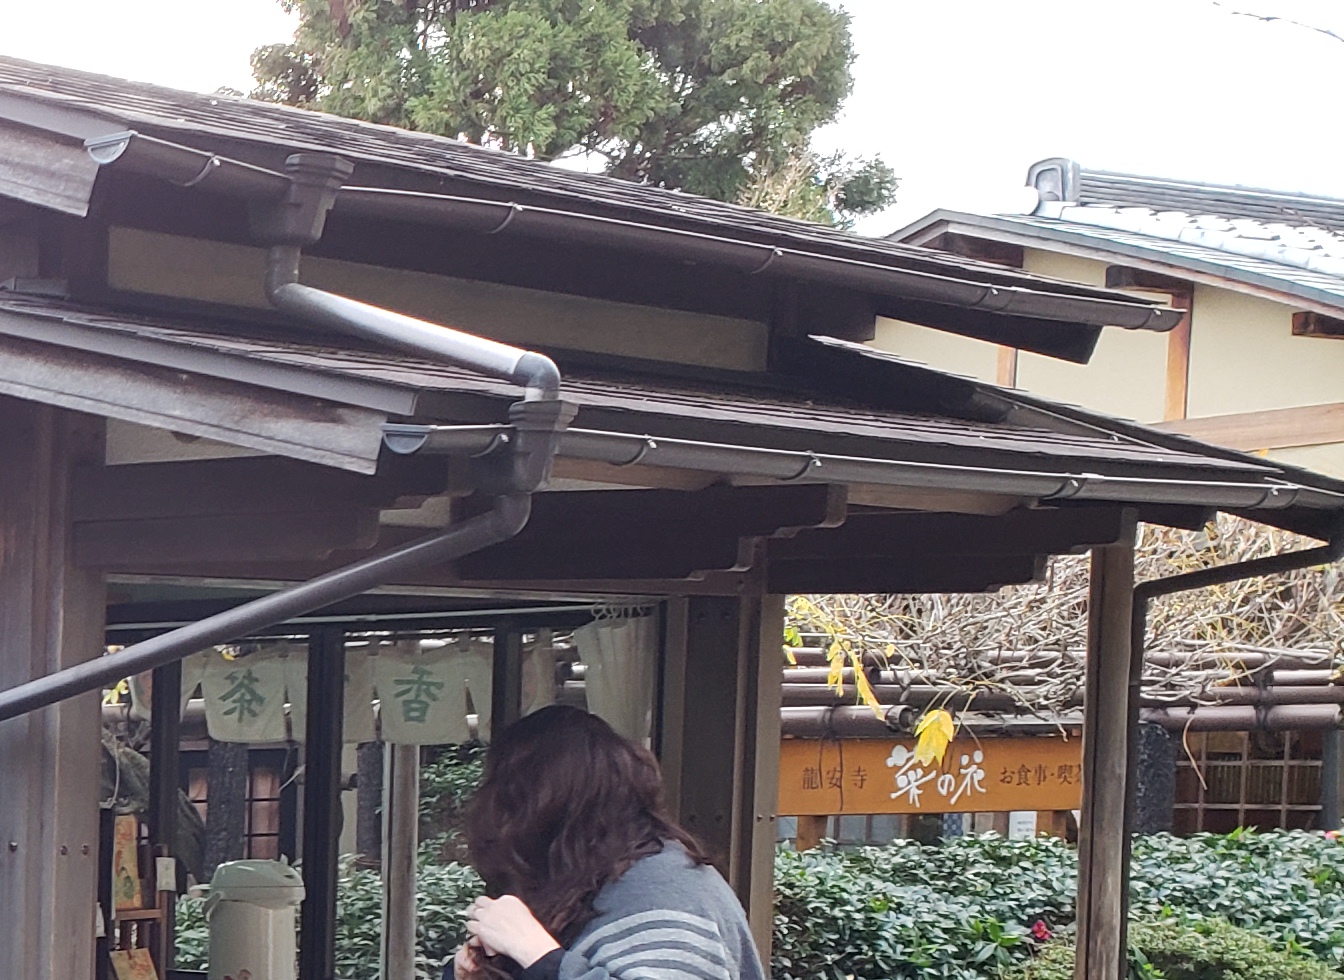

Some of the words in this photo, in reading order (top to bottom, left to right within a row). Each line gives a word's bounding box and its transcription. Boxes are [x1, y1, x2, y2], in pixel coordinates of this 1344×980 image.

[802, 765, 868, 791] 龍安寺
[886, 744, 987, 808] 菜の花
